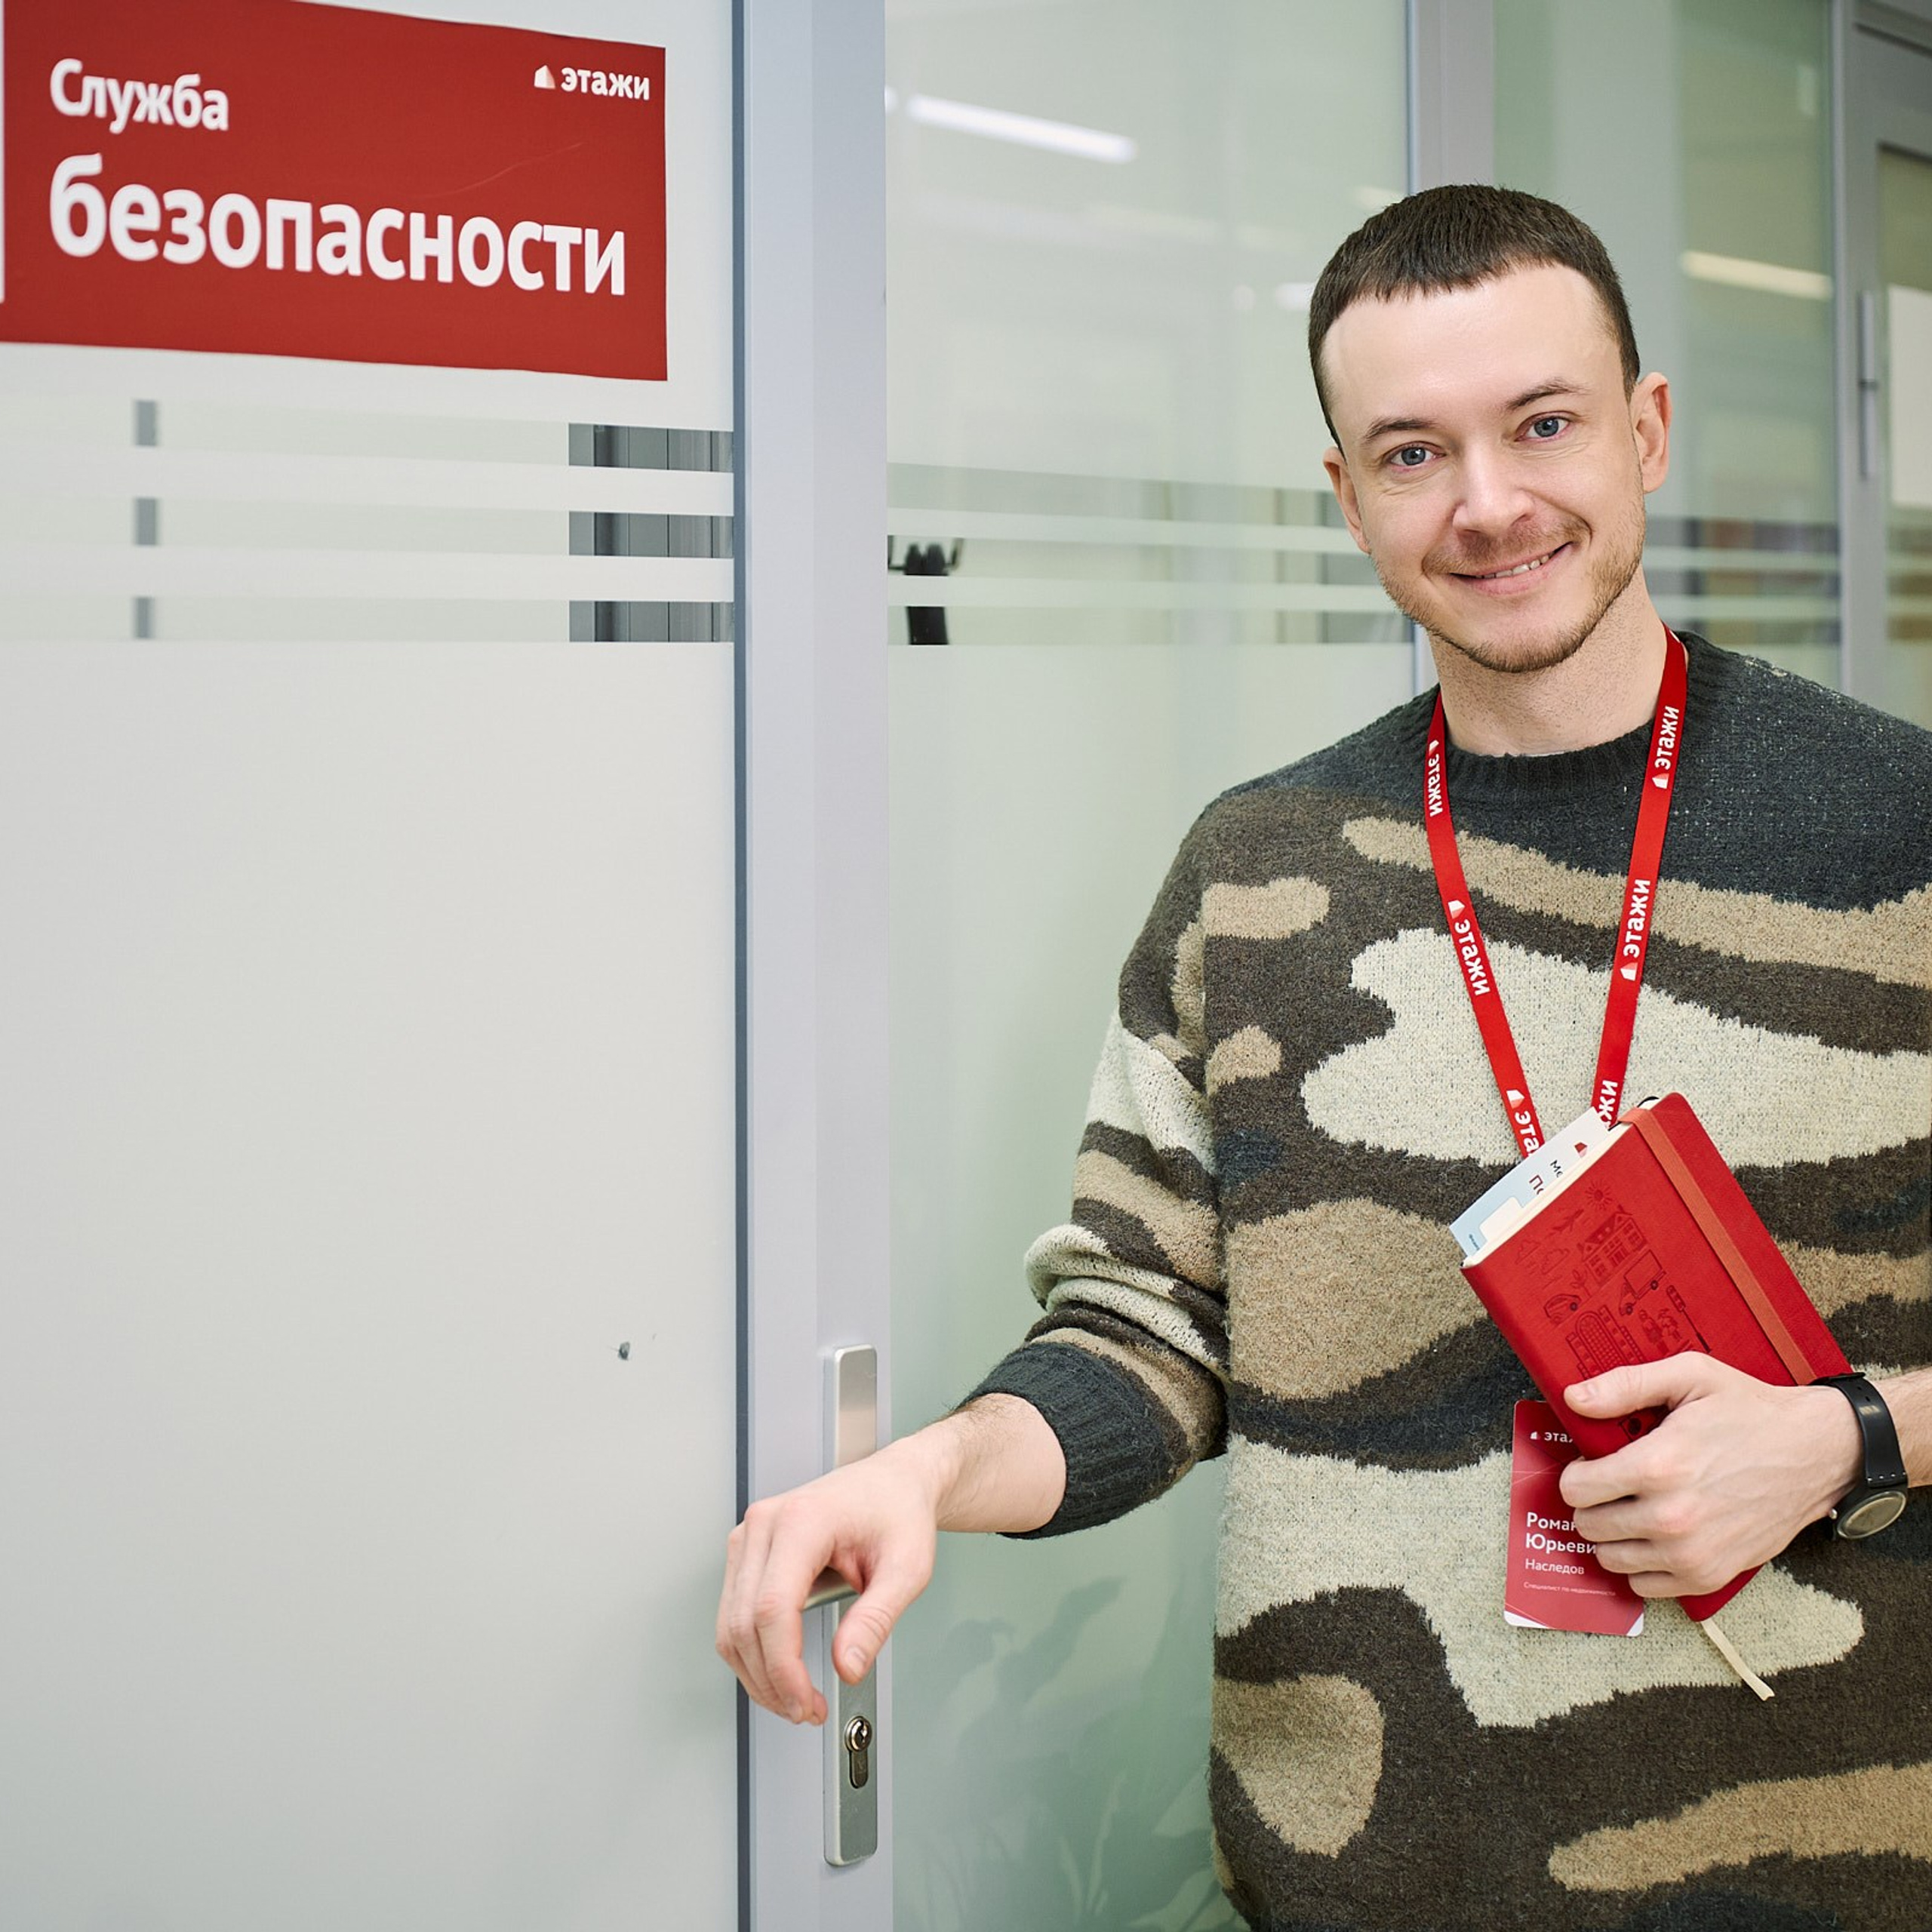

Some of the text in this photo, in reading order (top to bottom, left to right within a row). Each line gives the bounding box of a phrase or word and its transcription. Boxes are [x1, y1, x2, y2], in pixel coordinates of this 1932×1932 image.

[50, 58, 229, 134] Служба
[561, 66, 651, 101] этажи
[50, 152, 625, 296] безопасности
[1655, 706, 1680, 771] этажи
[1427, 753, 1444, 817] этажи
[1622, 878, 1651, 958] этажи
[1454, 918, 1491, 996] этажи
[1514, 1110, 1540, 1157] эта
[1543, 1431, 1574, 1444] эта
[1524, 1558, 1585, 1575] Наследов
[1526, 1532, 1597, 1555] Юрьеви
